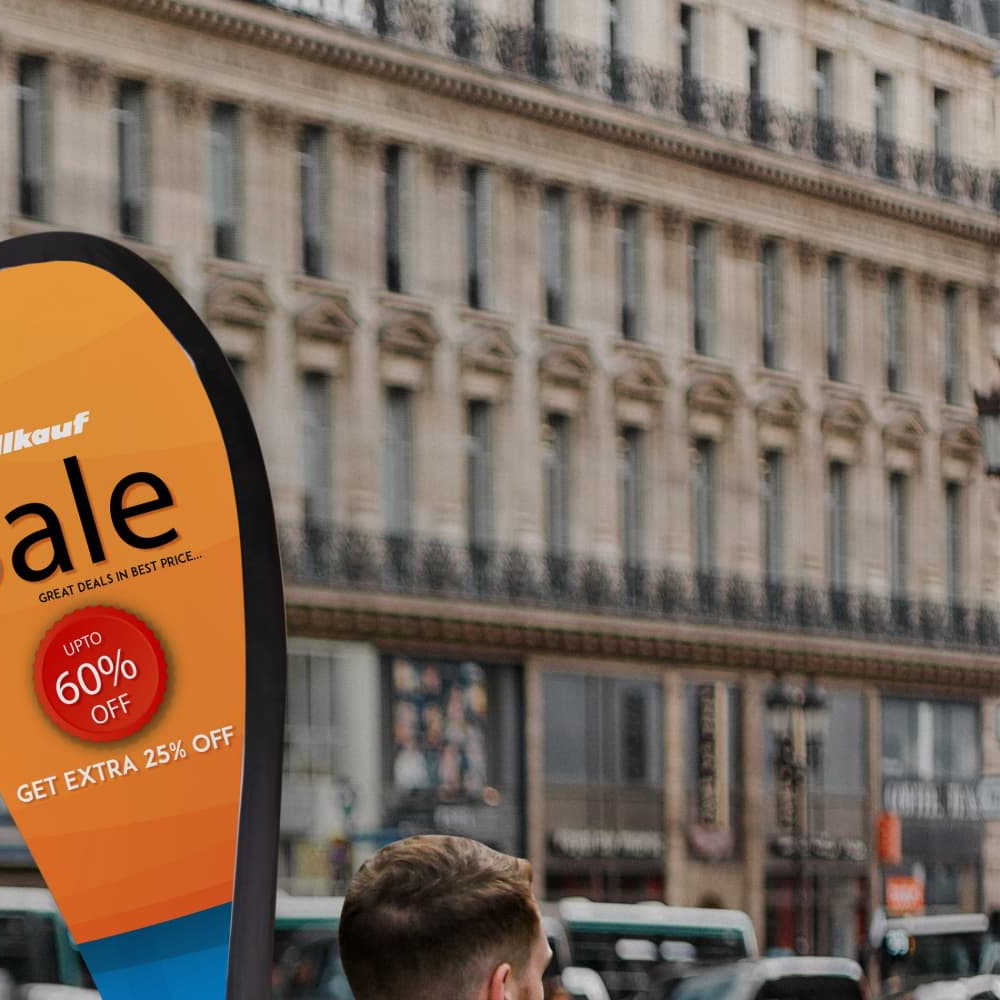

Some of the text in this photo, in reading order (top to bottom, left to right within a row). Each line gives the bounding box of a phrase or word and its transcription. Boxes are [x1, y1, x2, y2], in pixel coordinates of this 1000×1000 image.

[38, 584, 74, 603] GREAT
[77, 573, 114, 593] DEALS
[115, 569, 129, 582] IN
[131, 560, 157, 577] BEST
[63, 631, 102, 657] UPTO
[55, 648, 137, 705] 60%
[91, 693, 131, 724] OFF
[16, 725, 234, 803] GET EXTRA 25% OFF
